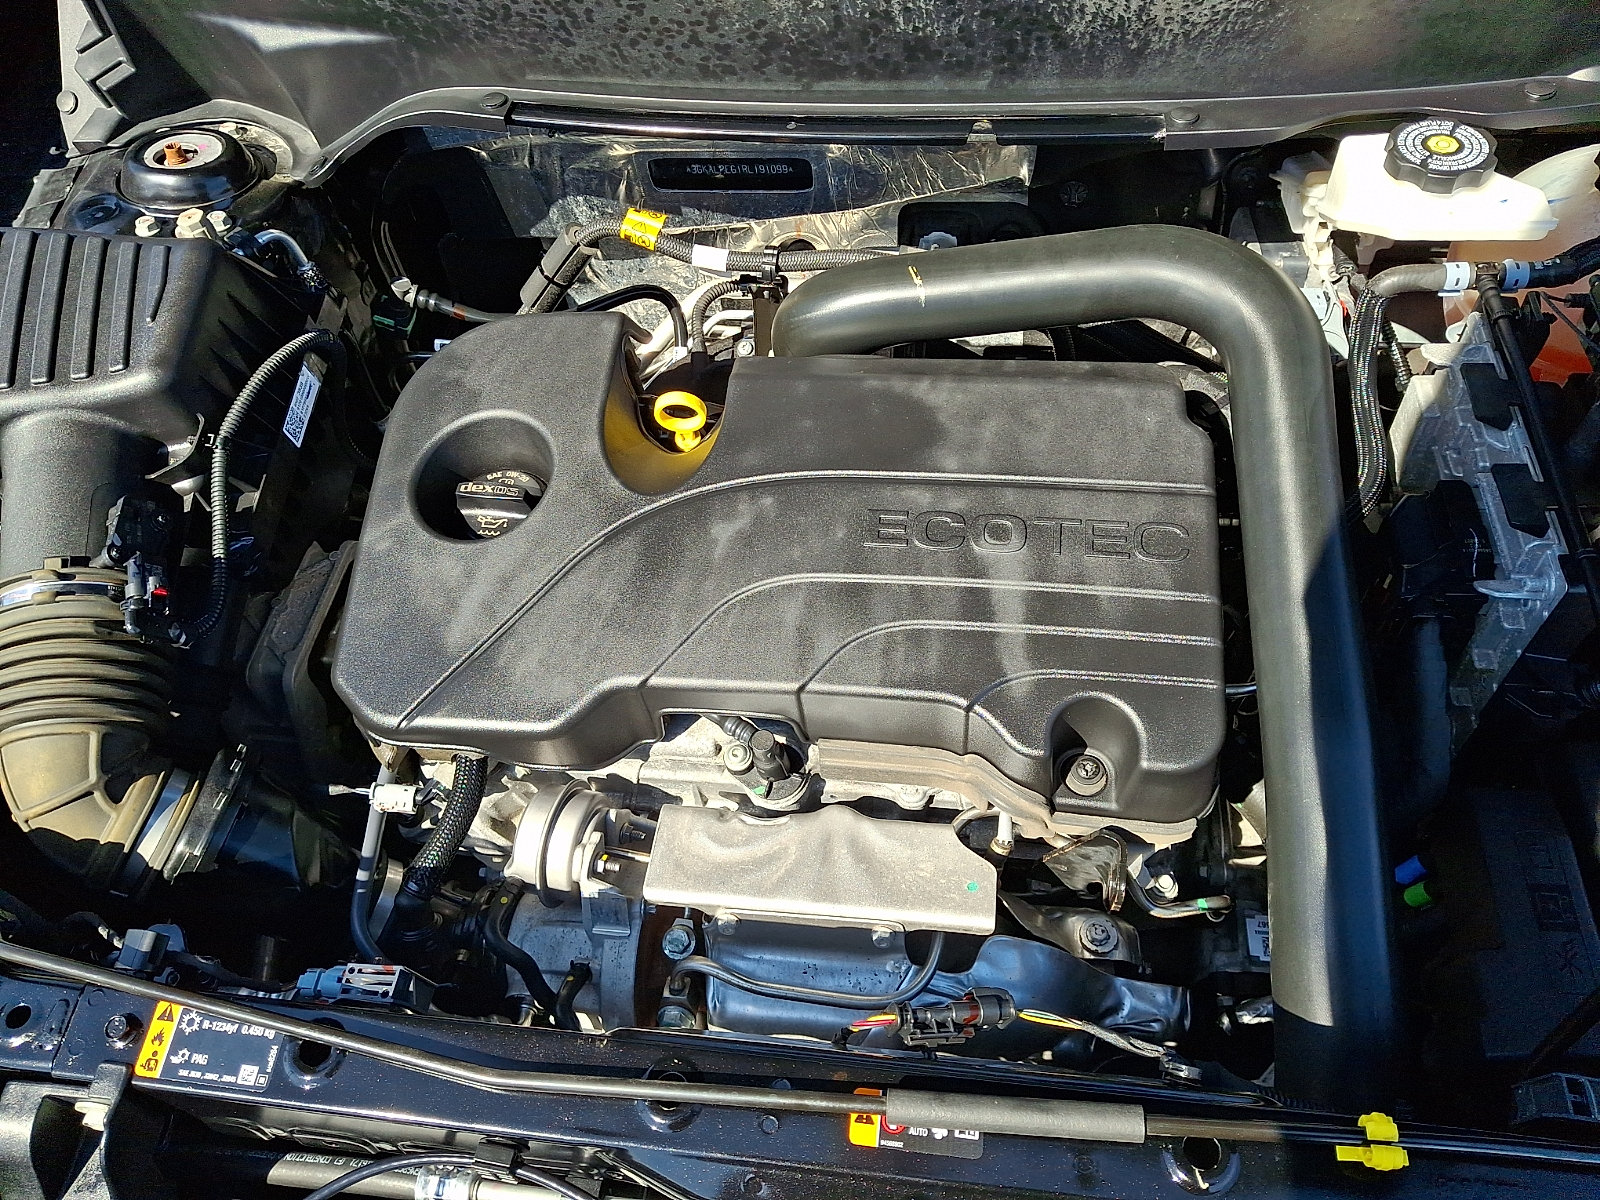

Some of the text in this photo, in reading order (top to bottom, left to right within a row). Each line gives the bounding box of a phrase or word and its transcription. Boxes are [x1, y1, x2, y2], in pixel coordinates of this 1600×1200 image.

[486, 471, 503, 481] SAE
[459, 482, 519, 497] dexos
[863, 507, 1190, 563] ECOTEC
[202, 1020, 240, 1035] R-1234yf
[241, 1024, 265, 1037] 0.450
[190, 1053, 209, 1065] PAG
[908, 1126, 928, 1137] AUTO
